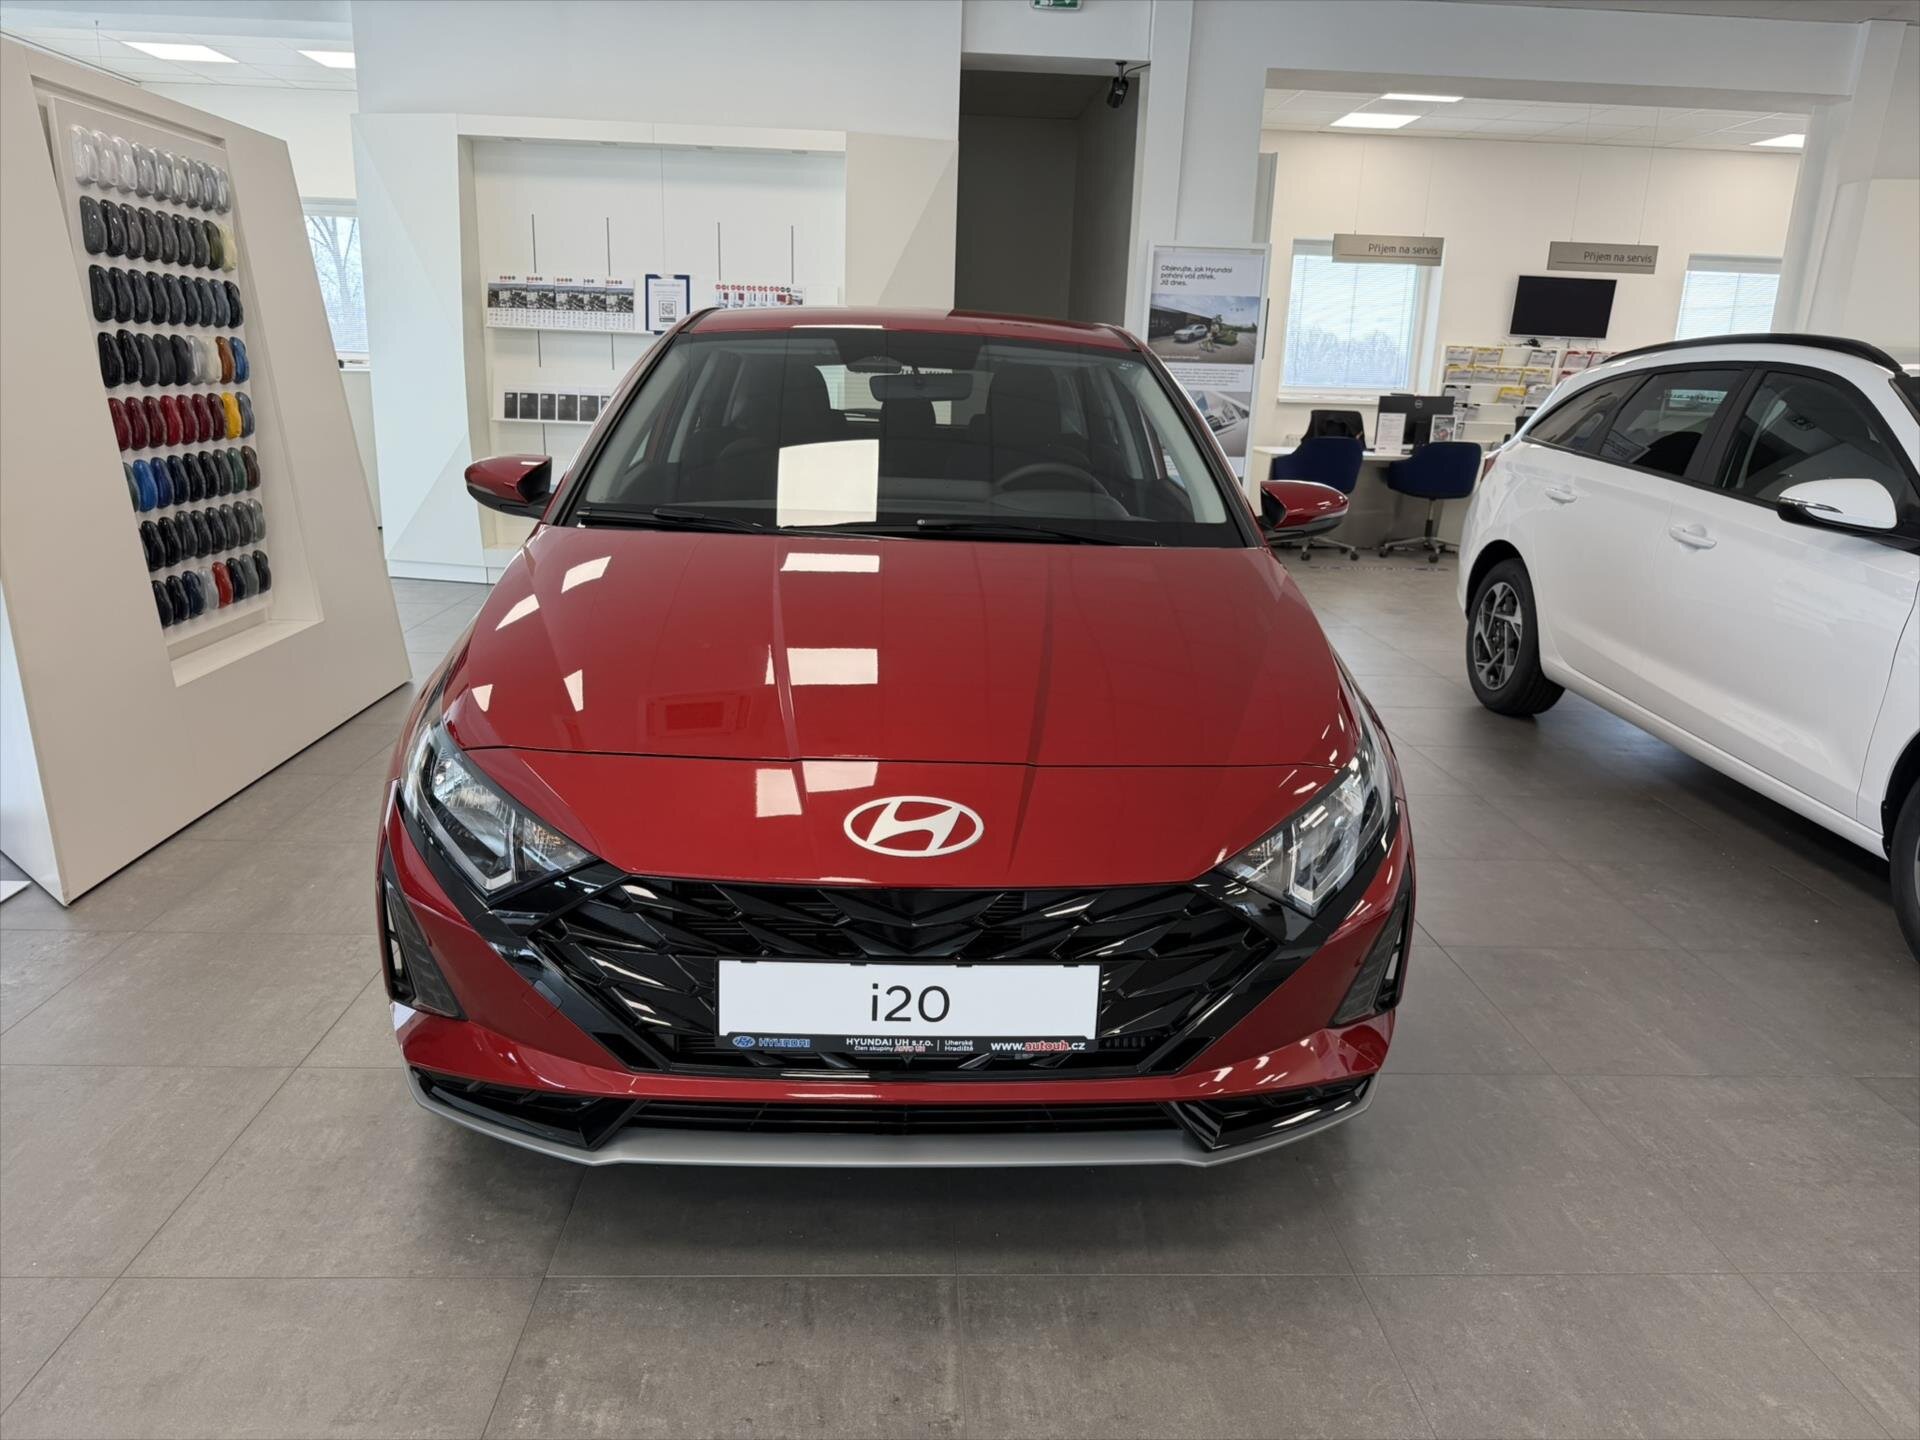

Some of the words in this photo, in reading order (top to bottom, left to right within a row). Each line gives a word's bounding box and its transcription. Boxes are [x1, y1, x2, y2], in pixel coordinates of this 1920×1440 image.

[1399, 246, 1410, 254] na
[1413, 246, 1439, 255] servis
[1613, 254, 1625, 262] na
[1626, 254, 1653, 263] servis
[872, 983, 950, 1022] i20
[758, 1038, 811, 1048] HYUNDAI
[846, 1038, 892, 1046] HYUNDAI
[894, 1038, 909, 1047] UH
[911, 1039, 934, 1047] s.r.o.
[990, 1040, 1085, 1052] www.autouh.cz
